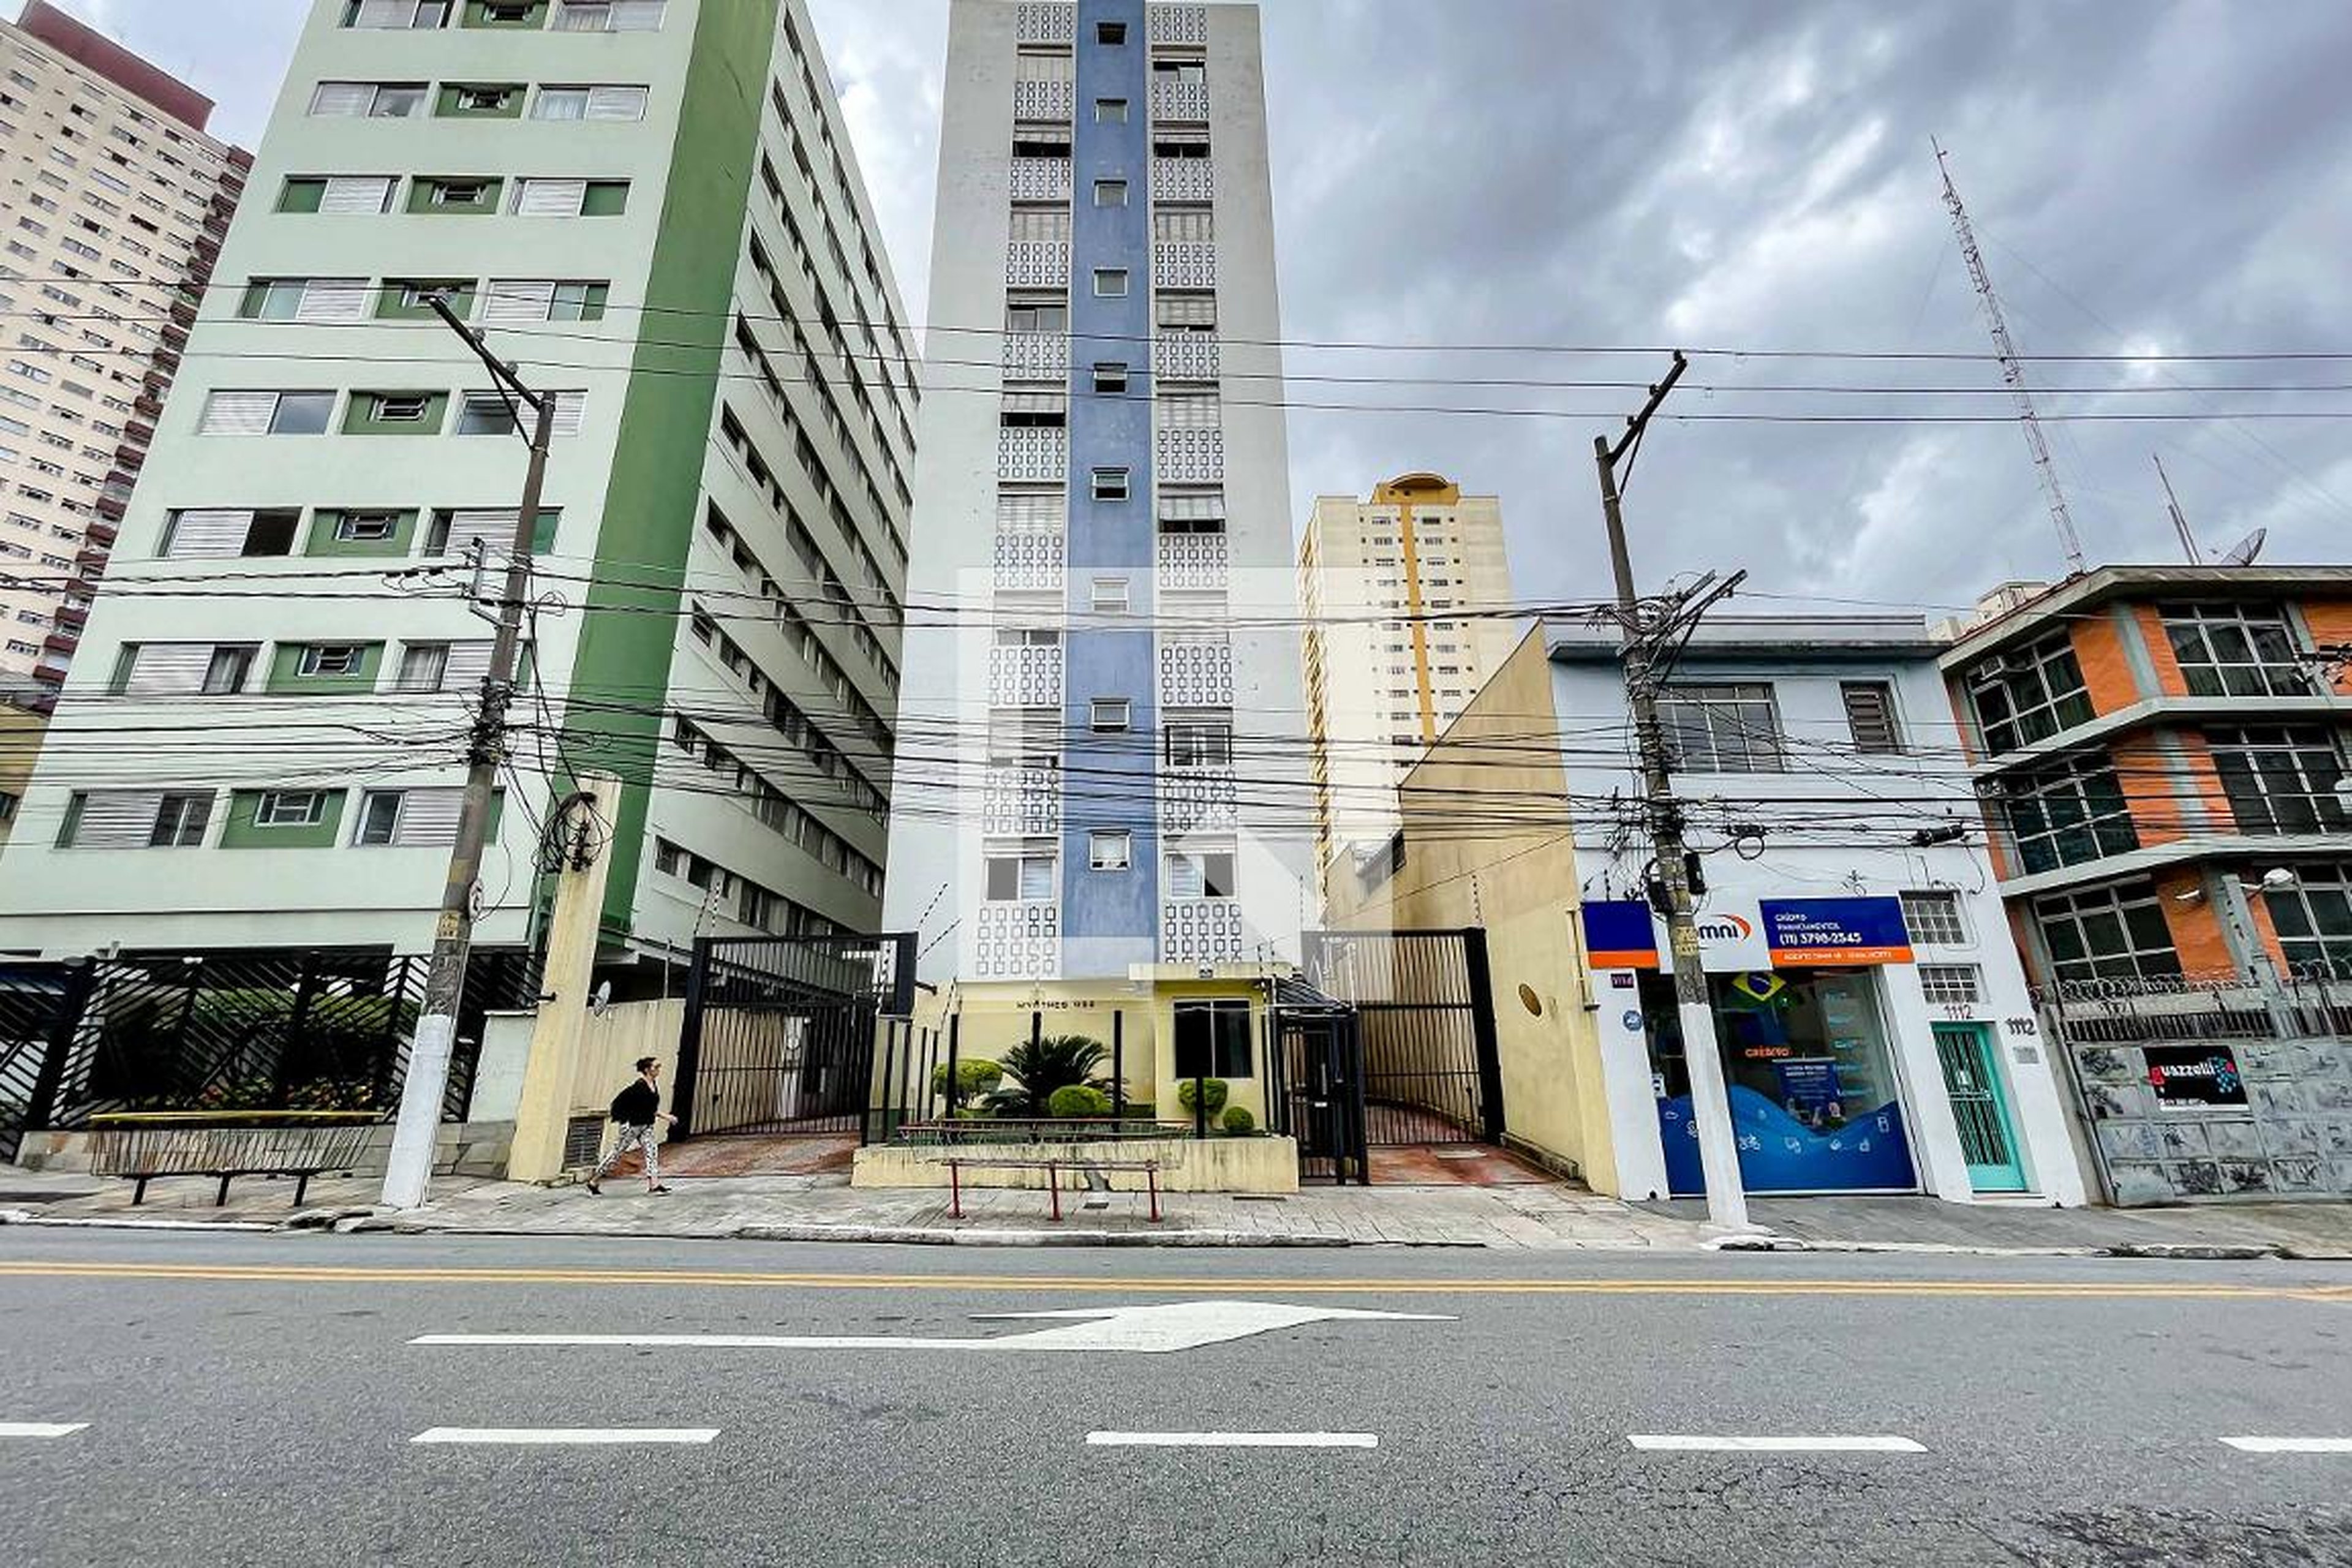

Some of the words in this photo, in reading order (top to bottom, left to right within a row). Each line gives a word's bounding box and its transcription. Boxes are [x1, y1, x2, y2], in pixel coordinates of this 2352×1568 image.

[1699, 924, 1738, 940] mni
[1944, 1005, 1973, 1019] 1112
[2005, 1017, 2036, 1035] 1112
